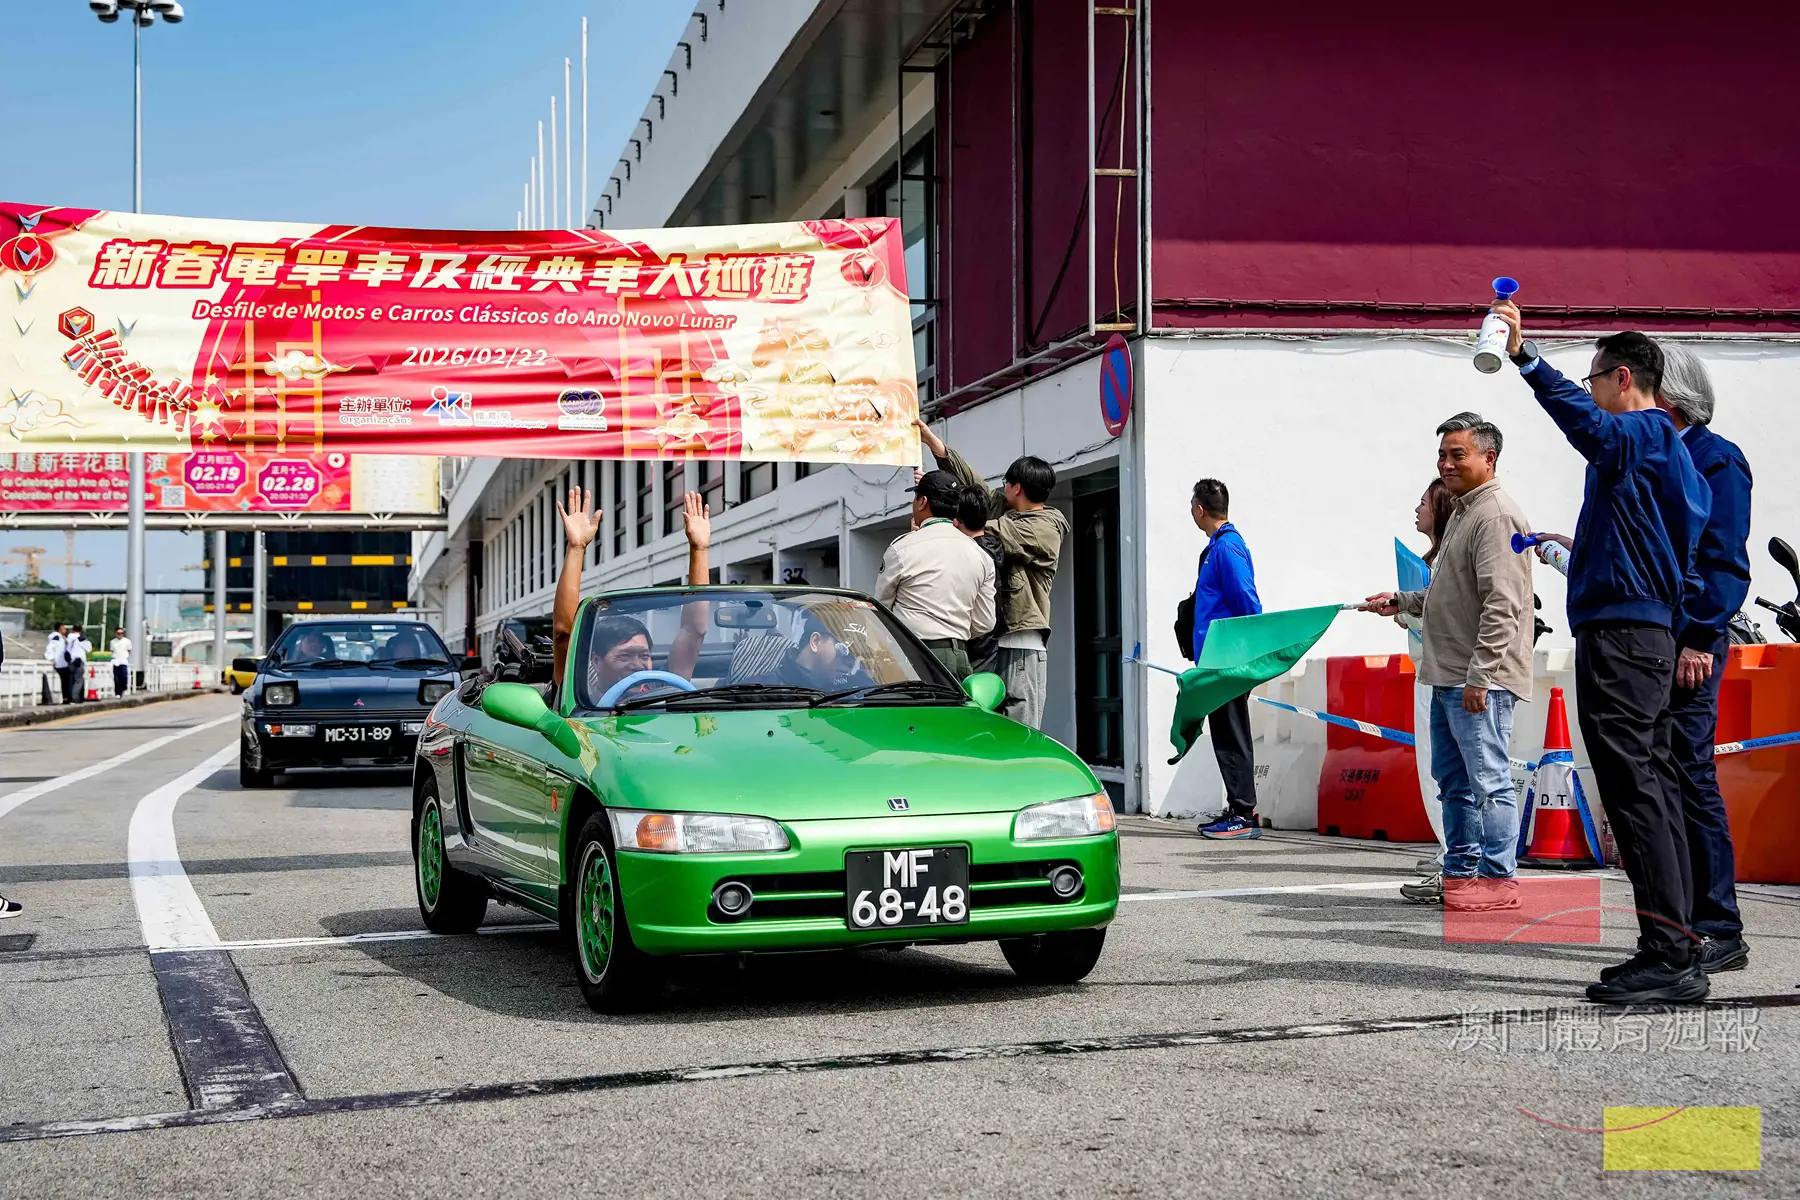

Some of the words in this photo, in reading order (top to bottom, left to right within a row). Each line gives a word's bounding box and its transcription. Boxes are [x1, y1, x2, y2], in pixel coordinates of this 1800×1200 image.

[92, 240, 812, 302] 新春電單車及經典車大巡遊
[195, 301, 267, 319] Desfile
[270, 302, 298, 319] de
[302, 303, 365, 320] Motos
[370, 308, 381, 320] e
[389, 304, 454, 321] Carros
[459, 304, 549, 324] Clássicos
[554, 307, 579, 325] do
[583, 310, 619, 326] Ano
[625, 311, 675, 327] Novo
[680, 313, 735, 330] Lunar
[401, 346, 548, 368] 2026/02/22
[340, 415, 411, 426] Organização:
[190, 466, 241, 481] 02.19
[262, 476, 316, 491] 02.28
[783, 568, 804, 584] 37
[325, 727, 392, 743] MC-31-89
[1344, 788, 1365, 802] DSAT
[1541, 794, 1553, 806] D.
[1557, 794, 1571, 807] T.
[883, 849, 934, 889] MF
[852, 885, 967, 928] 68-48
